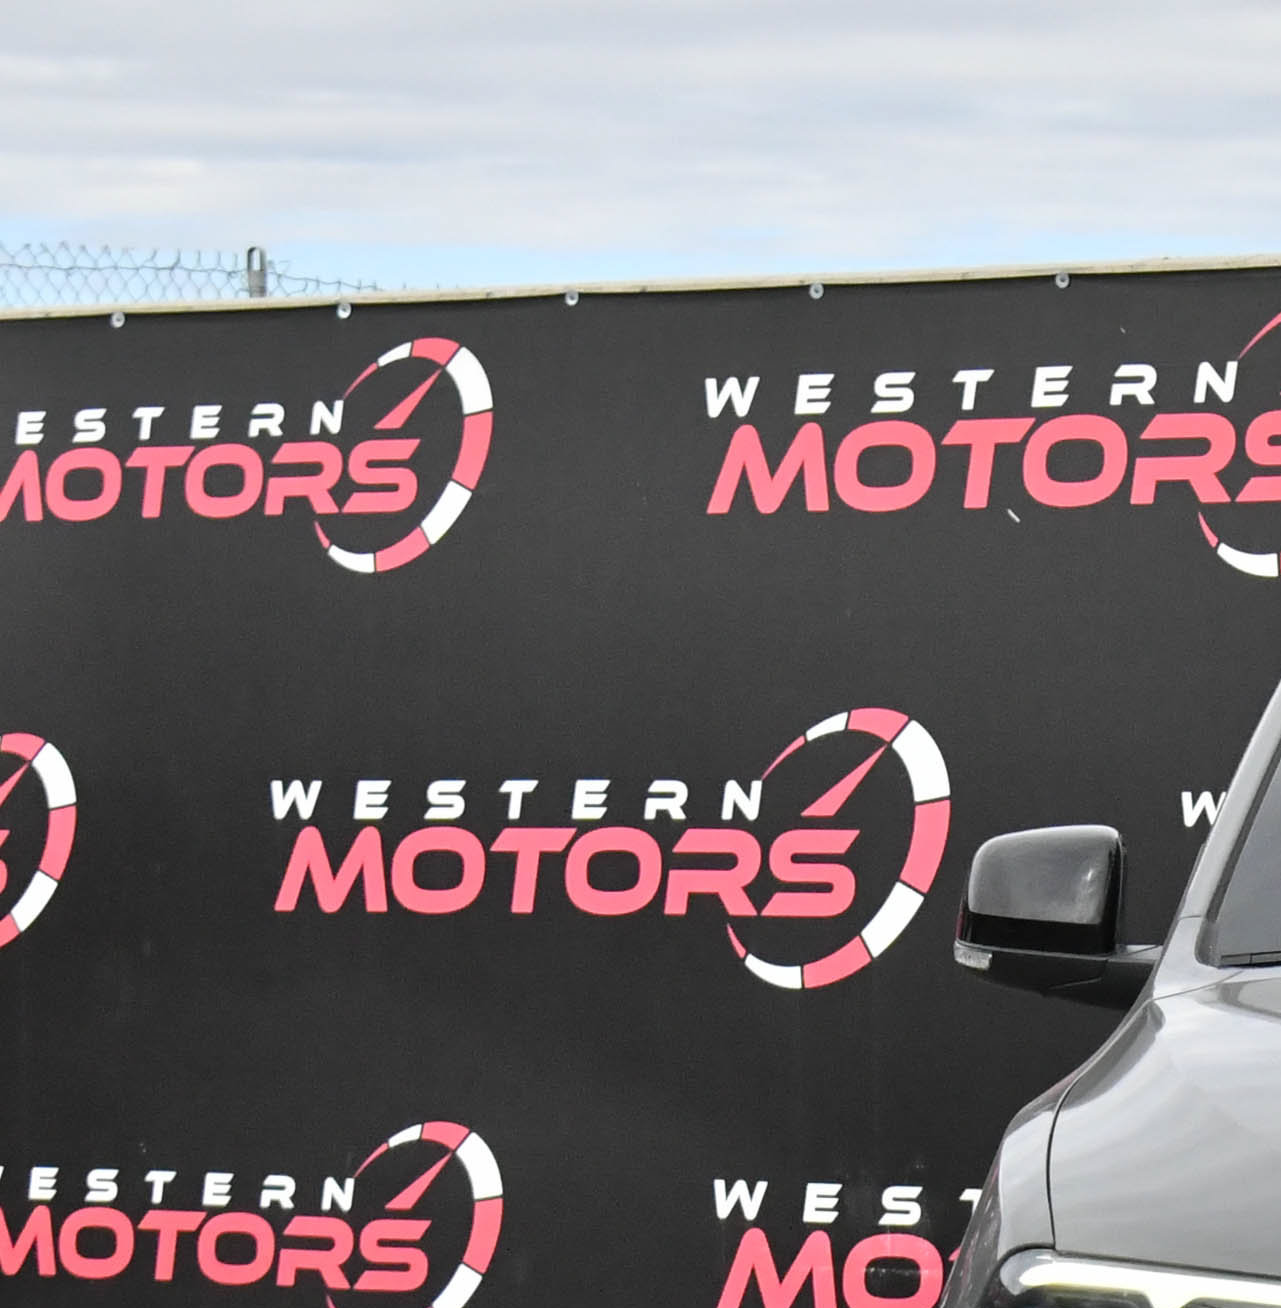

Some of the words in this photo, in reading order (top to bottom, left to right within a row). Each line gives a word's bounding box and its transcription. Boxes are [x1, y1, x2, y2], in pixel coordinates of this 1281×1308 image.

[704, 361, 1239, 419] WESTERN
[270, 779, 763, 822] WESTERN
[274, 826, 861, 918] MOTORS
[0, 1166, 355, 1212] ESTERN
